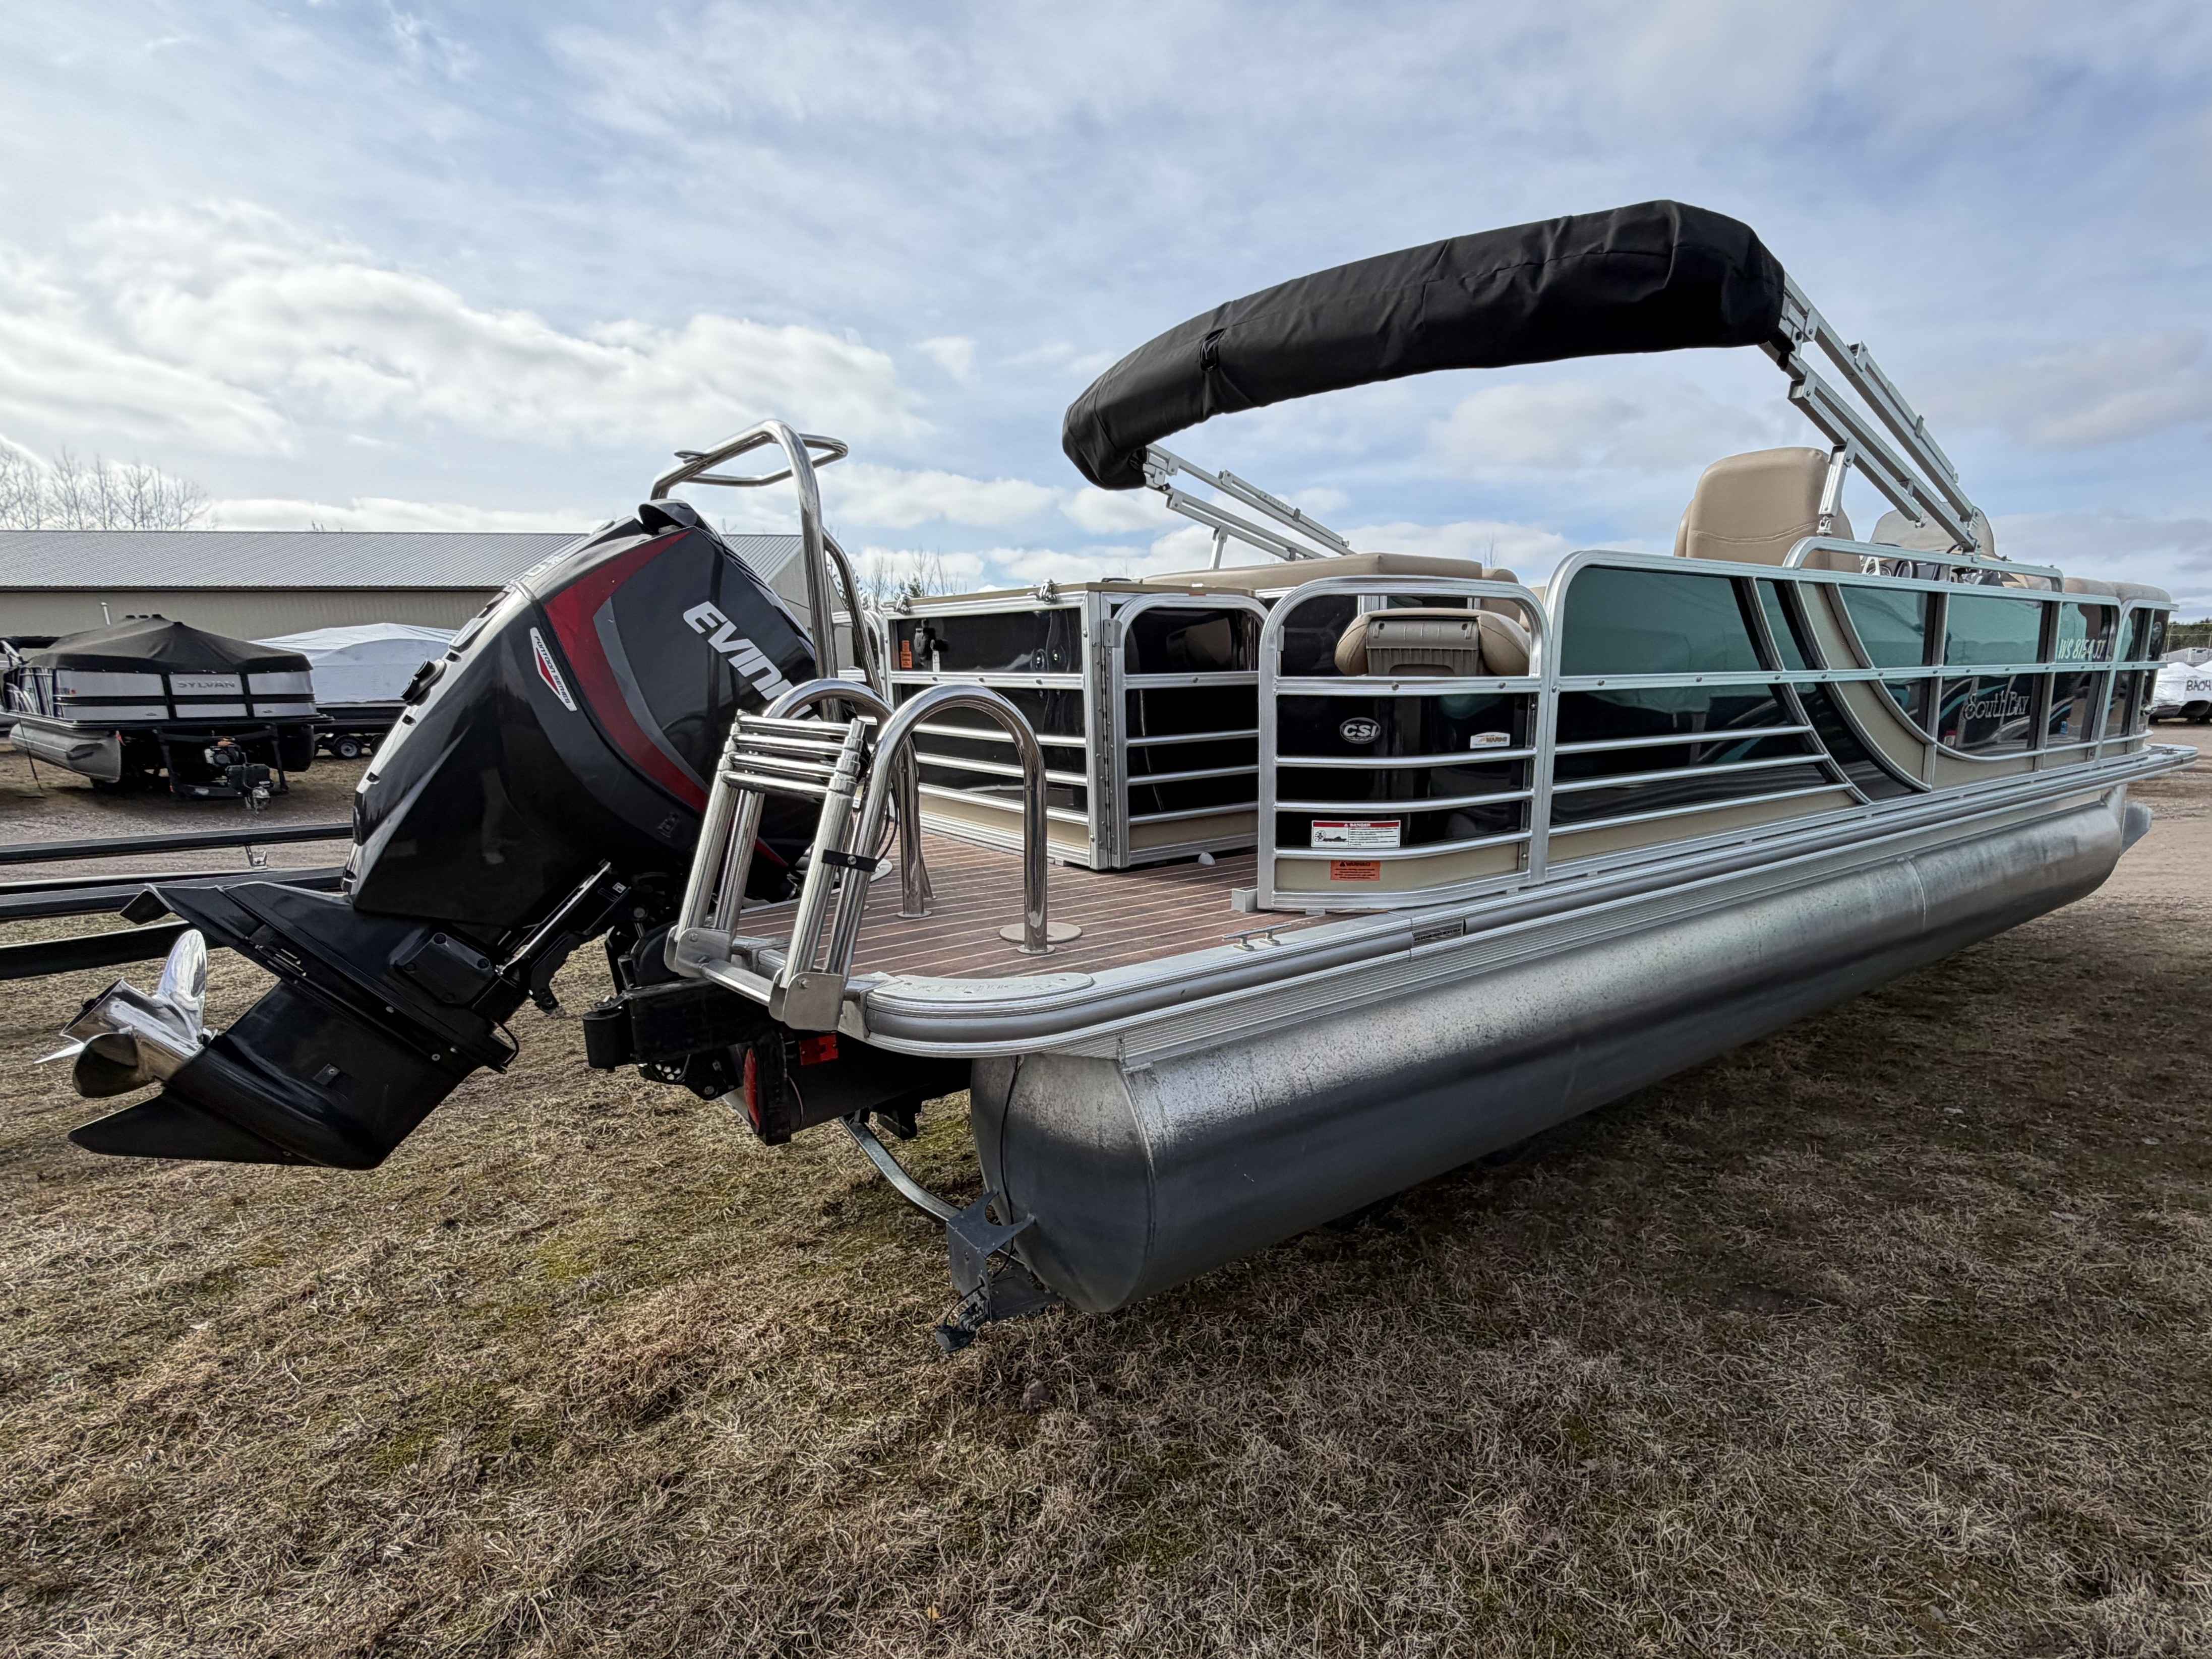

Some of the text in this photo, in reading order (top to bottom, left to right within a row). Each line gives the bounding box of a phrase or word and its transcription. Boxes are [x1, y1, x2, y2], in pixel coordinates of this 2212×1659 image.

[2058, 638, 2074, 659] WS
[534, 636, 571, 704] PONTOON SERIES
[1343, 724, 1377, 736] CSI
